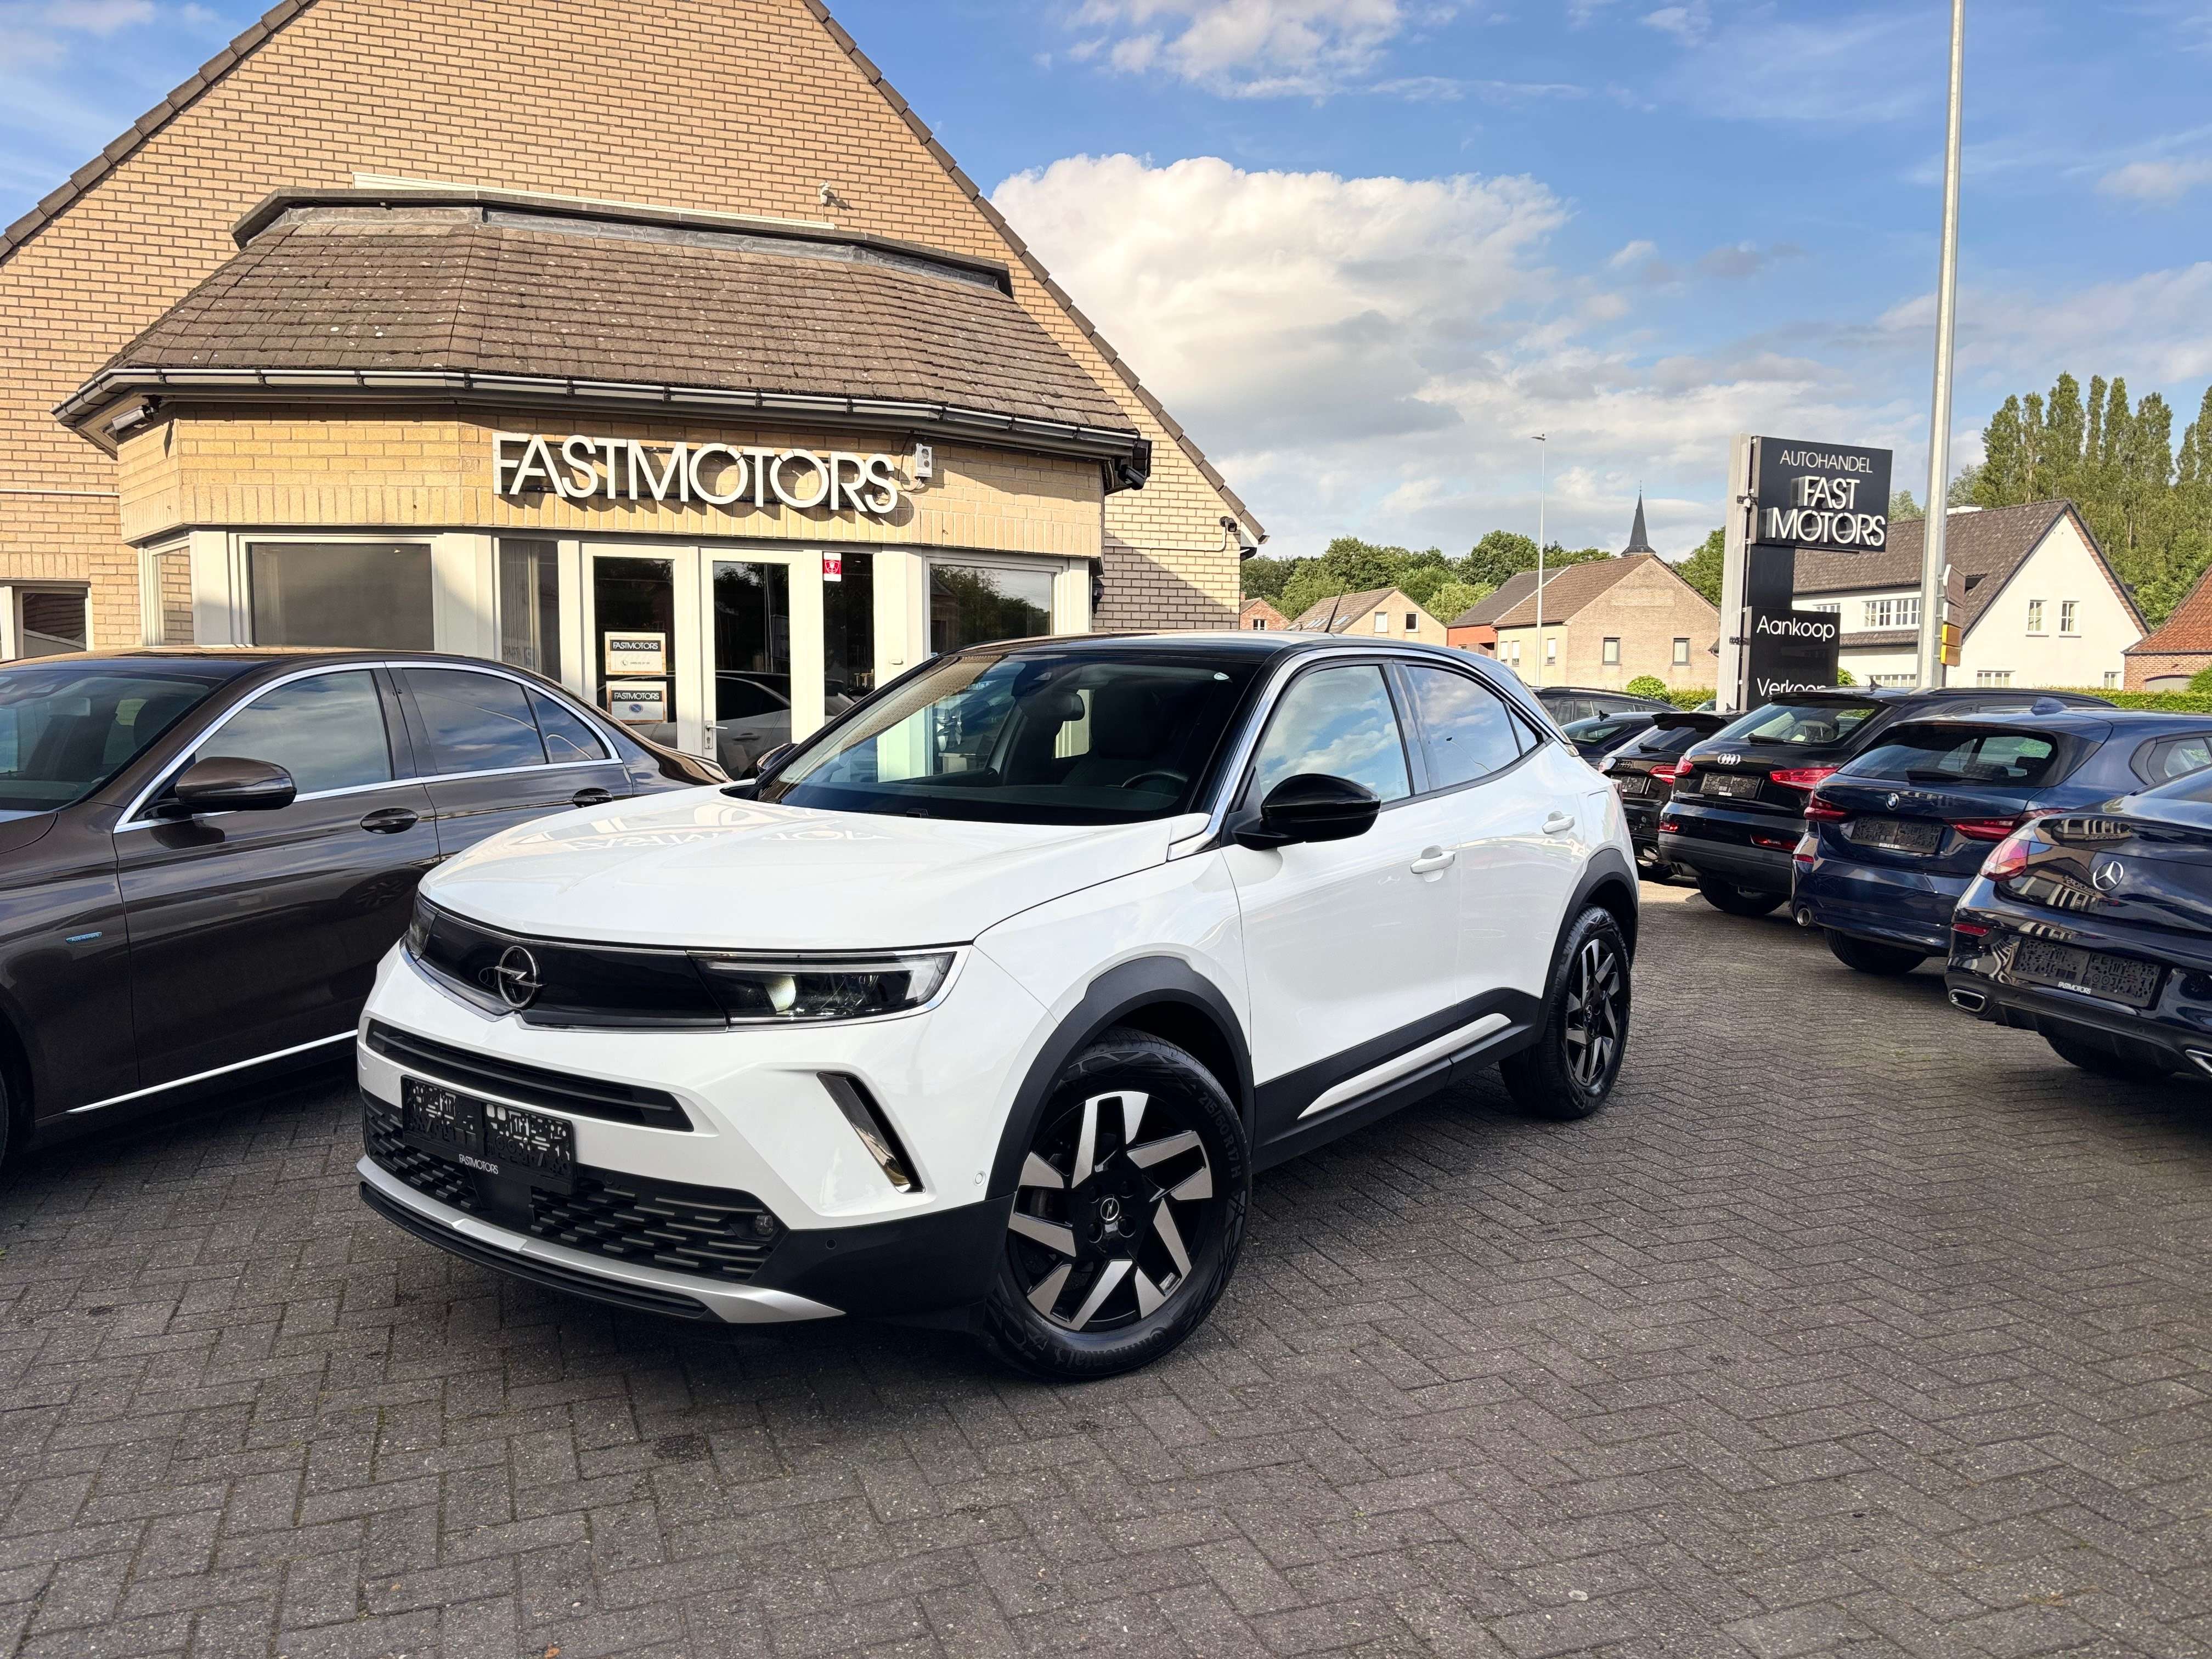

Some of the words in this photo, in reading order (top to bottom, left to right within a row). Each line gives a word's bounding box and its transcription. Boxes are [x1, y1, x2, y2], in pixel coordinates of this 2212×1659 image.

[493, 432, 898, 514] FASTMOTORS
[1780, 449, 1873, 473] AUTOHANDEL
[1803, 475, 1860, 510] FAST
[1771, 507, 1886, 546] MOTORS
[1756, 615, 1835, 642] Aankoop
[613, 641, 658, 650] FASTMOTORS
[614, 692, 660, 700] FASTMOTORS
[459, 1154, 499, 1175] FASTMOTORS
